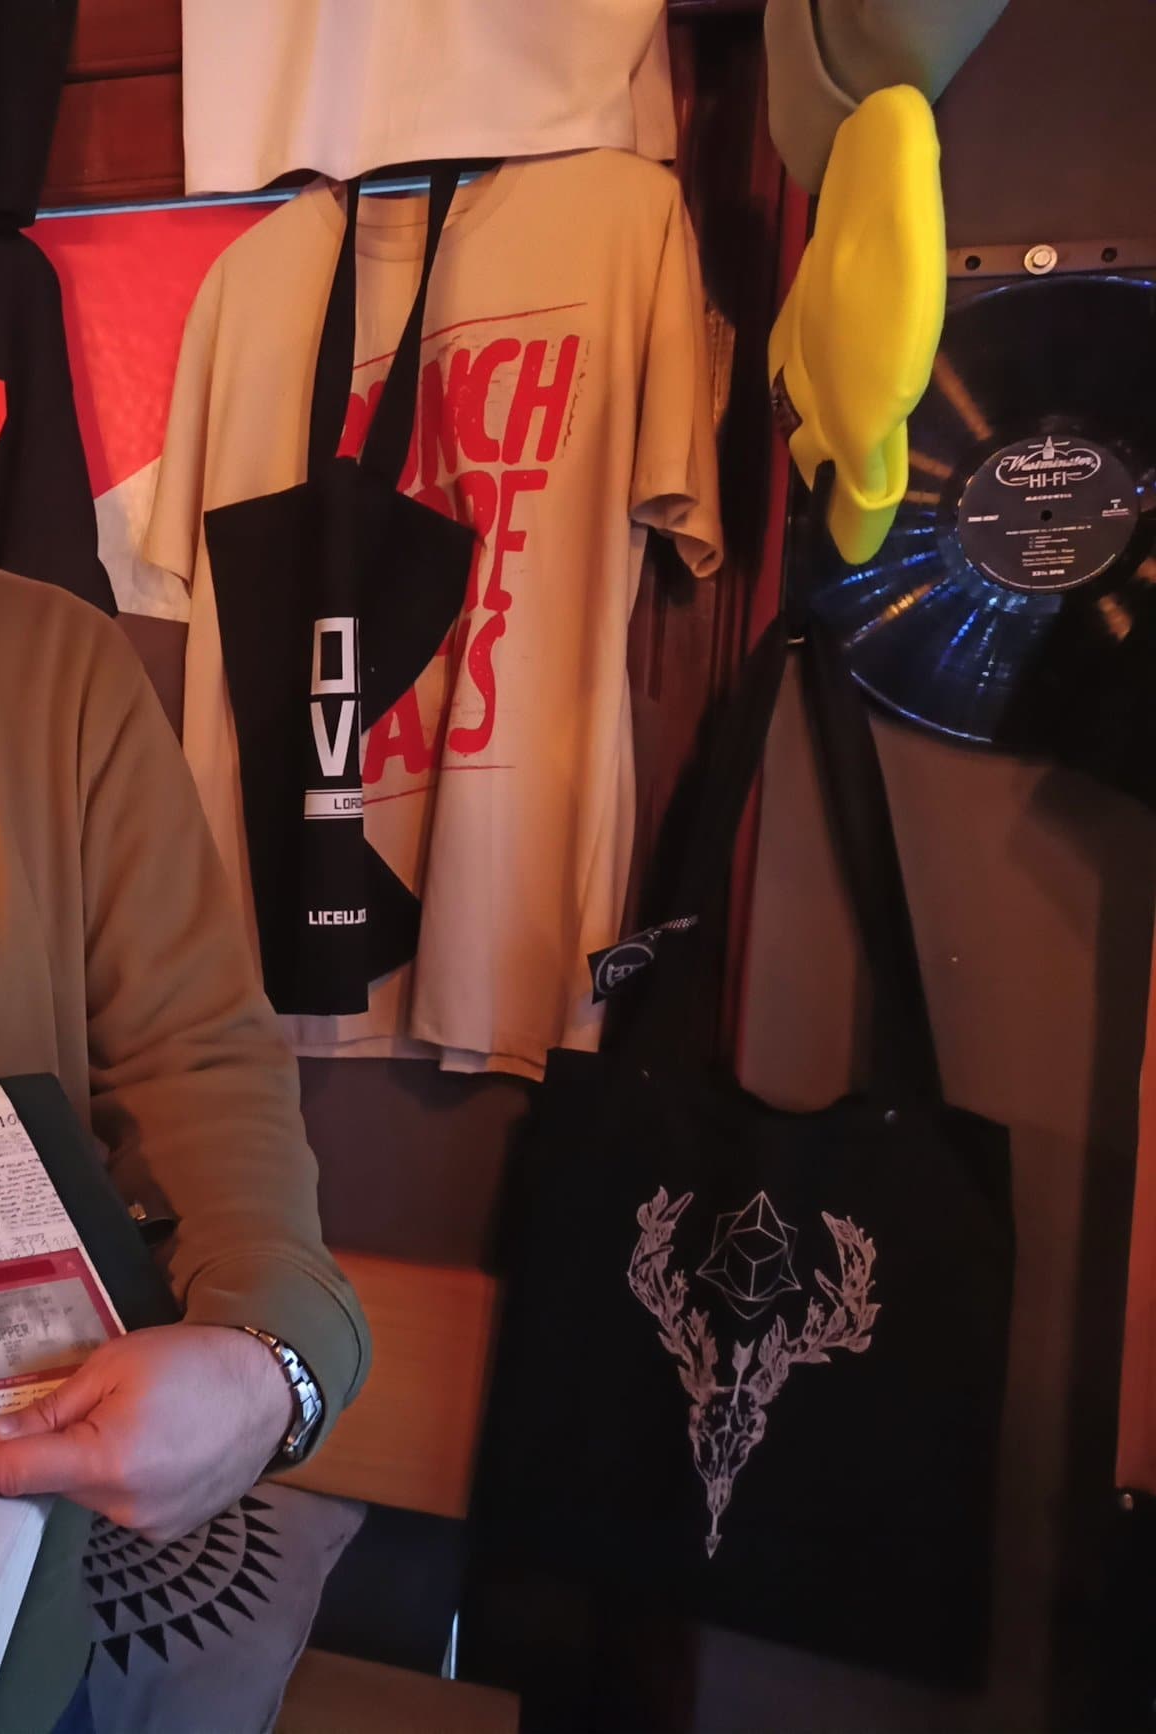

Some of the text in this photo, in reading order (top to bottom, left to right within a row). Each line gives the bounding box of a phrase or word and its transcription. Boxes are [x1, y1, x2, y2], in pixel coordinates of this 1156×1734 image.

[1029, 471, 1067, 489] HI-FI
[310, 617, 361, 696] O
[310, 700, 362, 777] V
